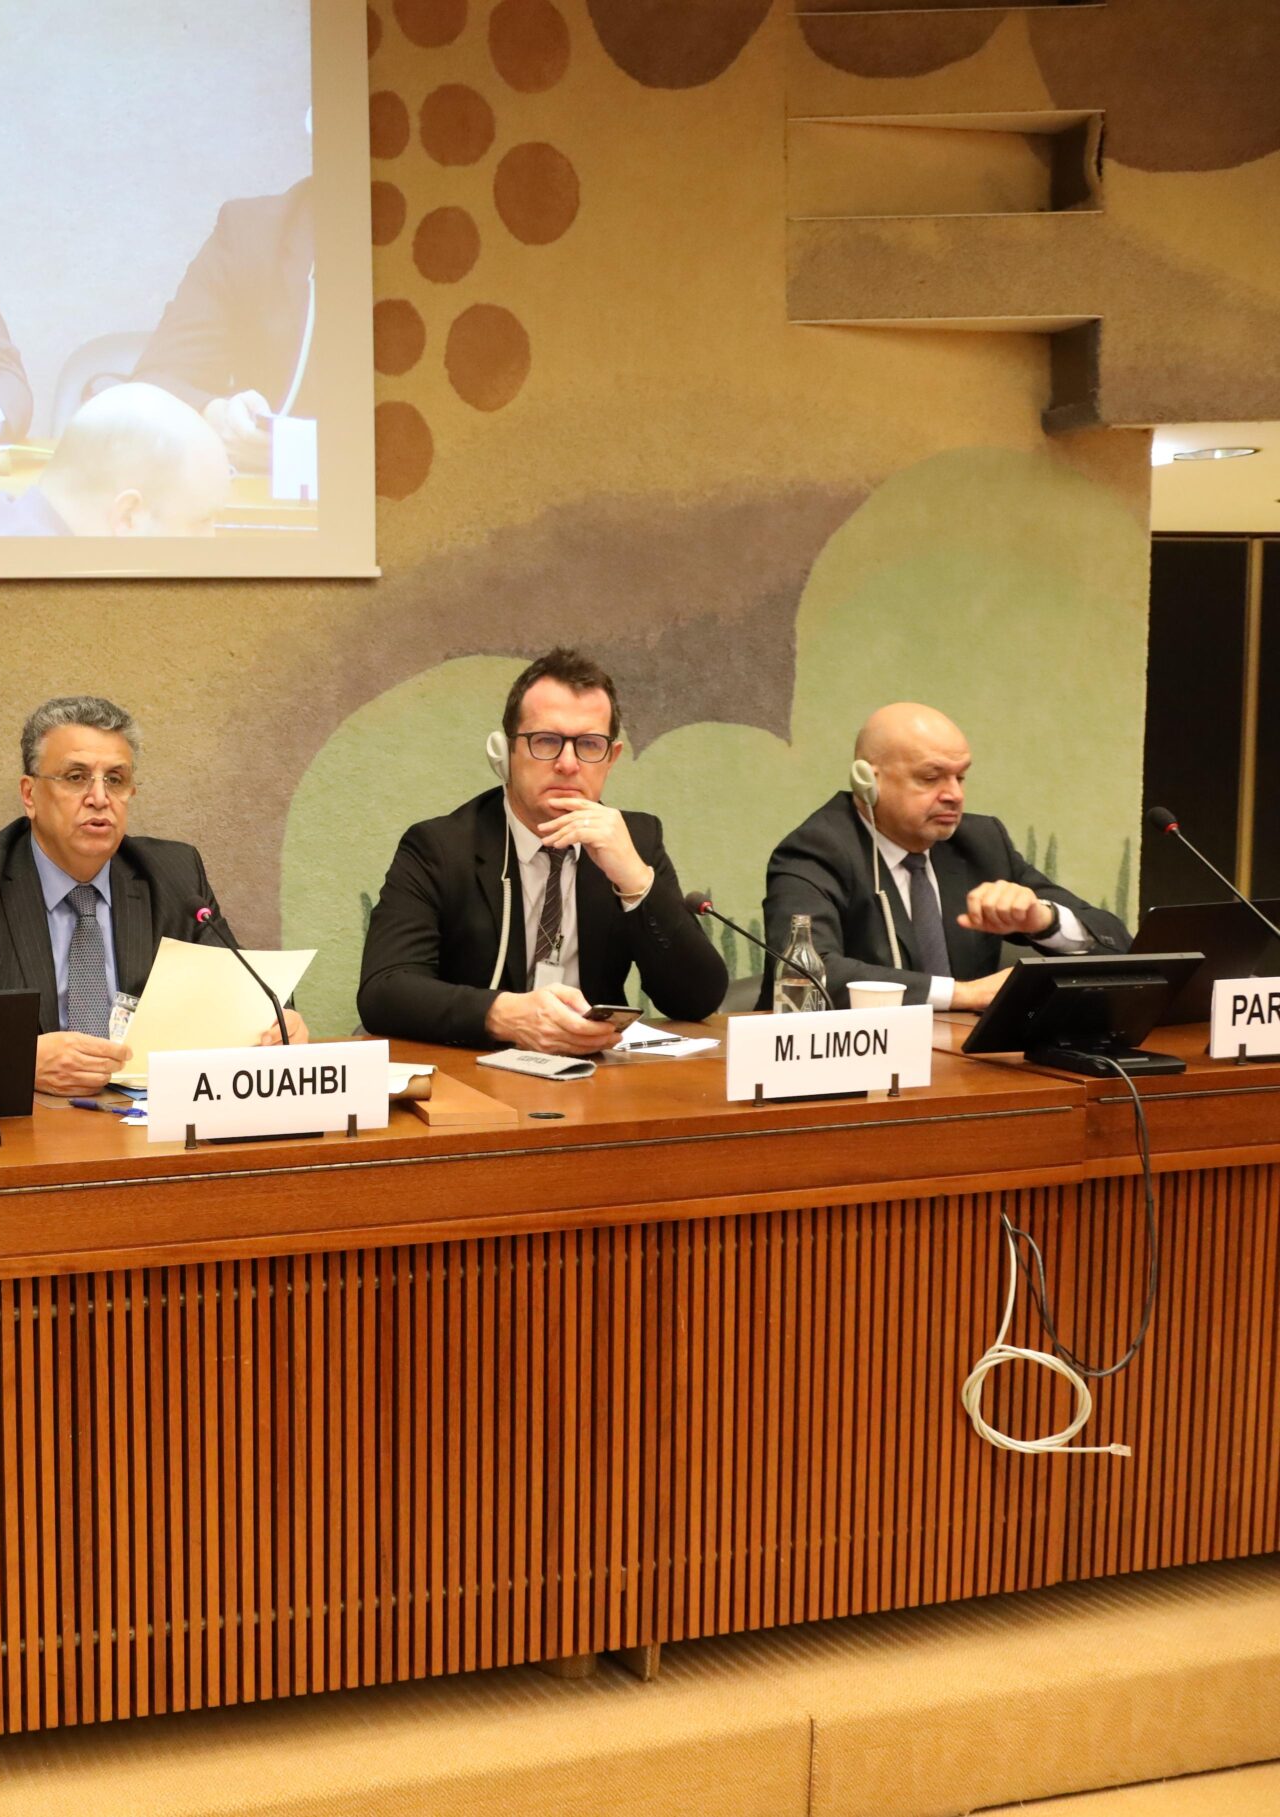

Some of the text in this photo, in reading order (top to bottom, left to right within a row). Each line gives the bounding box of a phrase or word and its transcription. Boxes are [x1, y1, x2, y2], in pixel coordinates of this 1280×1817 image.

[1231, 992, 1280, 1027] PAR
[775, 1028, 888, 1062] M. LIMON
[192, 1064, 347, 1102] A. OUAHBI
